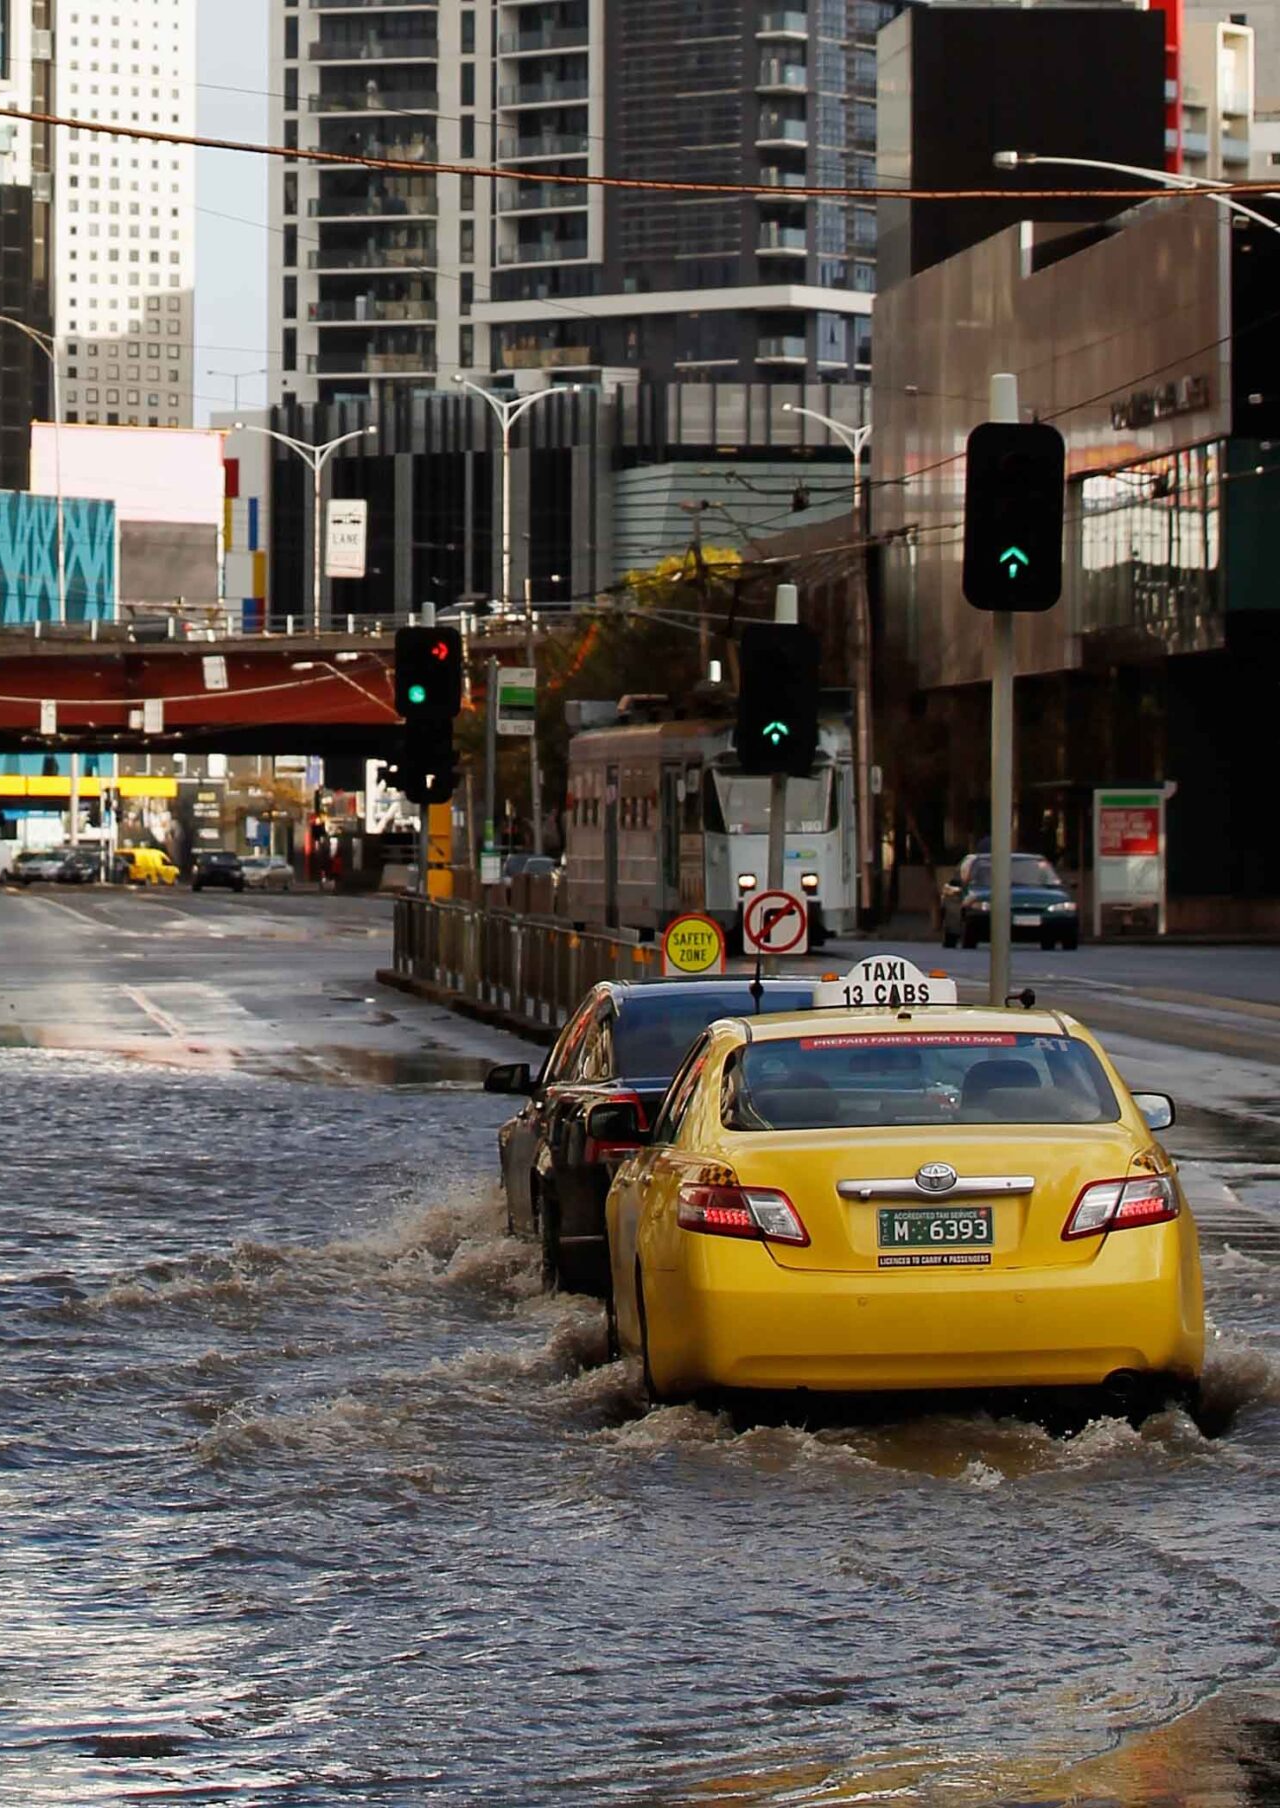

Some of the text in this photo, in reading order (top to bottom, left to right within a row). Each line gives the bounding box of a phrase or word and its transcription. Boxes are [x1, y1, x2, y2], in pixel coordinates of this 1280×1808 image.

[331, 533, 358, 545] LANE
[673, 931, 713, 945] SAFETY
[680, 949, 706, 962] ZONE
[862, 962, 905, 981] TAXI
[843, 984, 929, 1005] 13 CABS
[813, 1037, 867, 1046] PREPAID
[871, 1036, 913, 1044] FARES
[916, 1036, 951, 1044] 10PM
[894, 1210, 977, 1220] ACCREDITED TAXI SERVICE
[894, 1219, 988, 1241] M 6393
[912, 1256, 920, 1264] TO
[921, 1256, 942, 1264] CARRY
[949, 1254, 989, 1263] PASSENGERS
